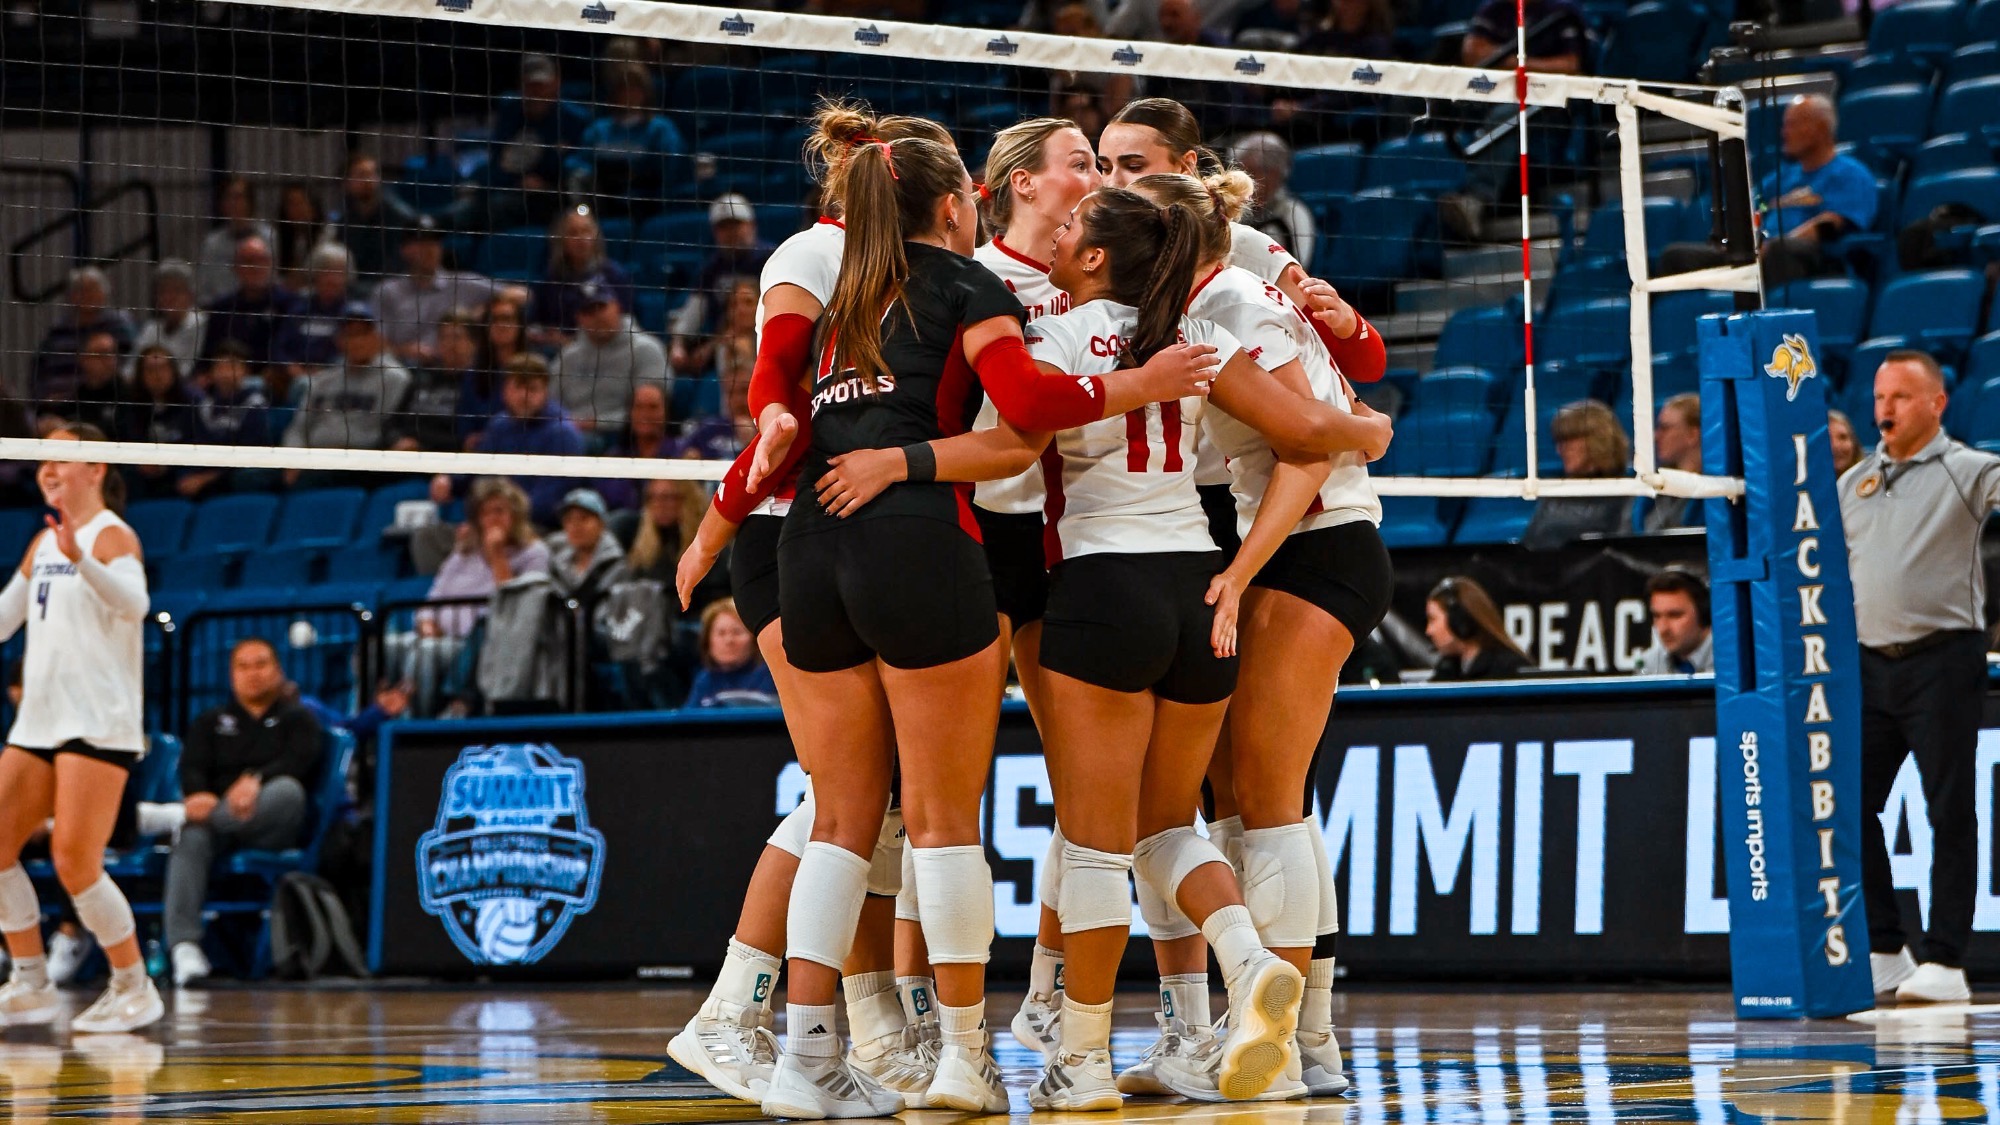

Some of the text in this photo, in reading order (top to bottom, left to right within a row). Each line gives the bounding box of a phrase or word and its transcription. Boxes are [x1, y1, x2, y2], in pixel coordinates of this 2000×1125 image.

[1125, 399, 1184, 473] 11
[37, 582, 51, 620] 4
[1792, 434, 1850, 967] JACKRABBITS
[452, 773, 573, 811] SUMMIT
[1739, 730, 1769, 902] sports imports
